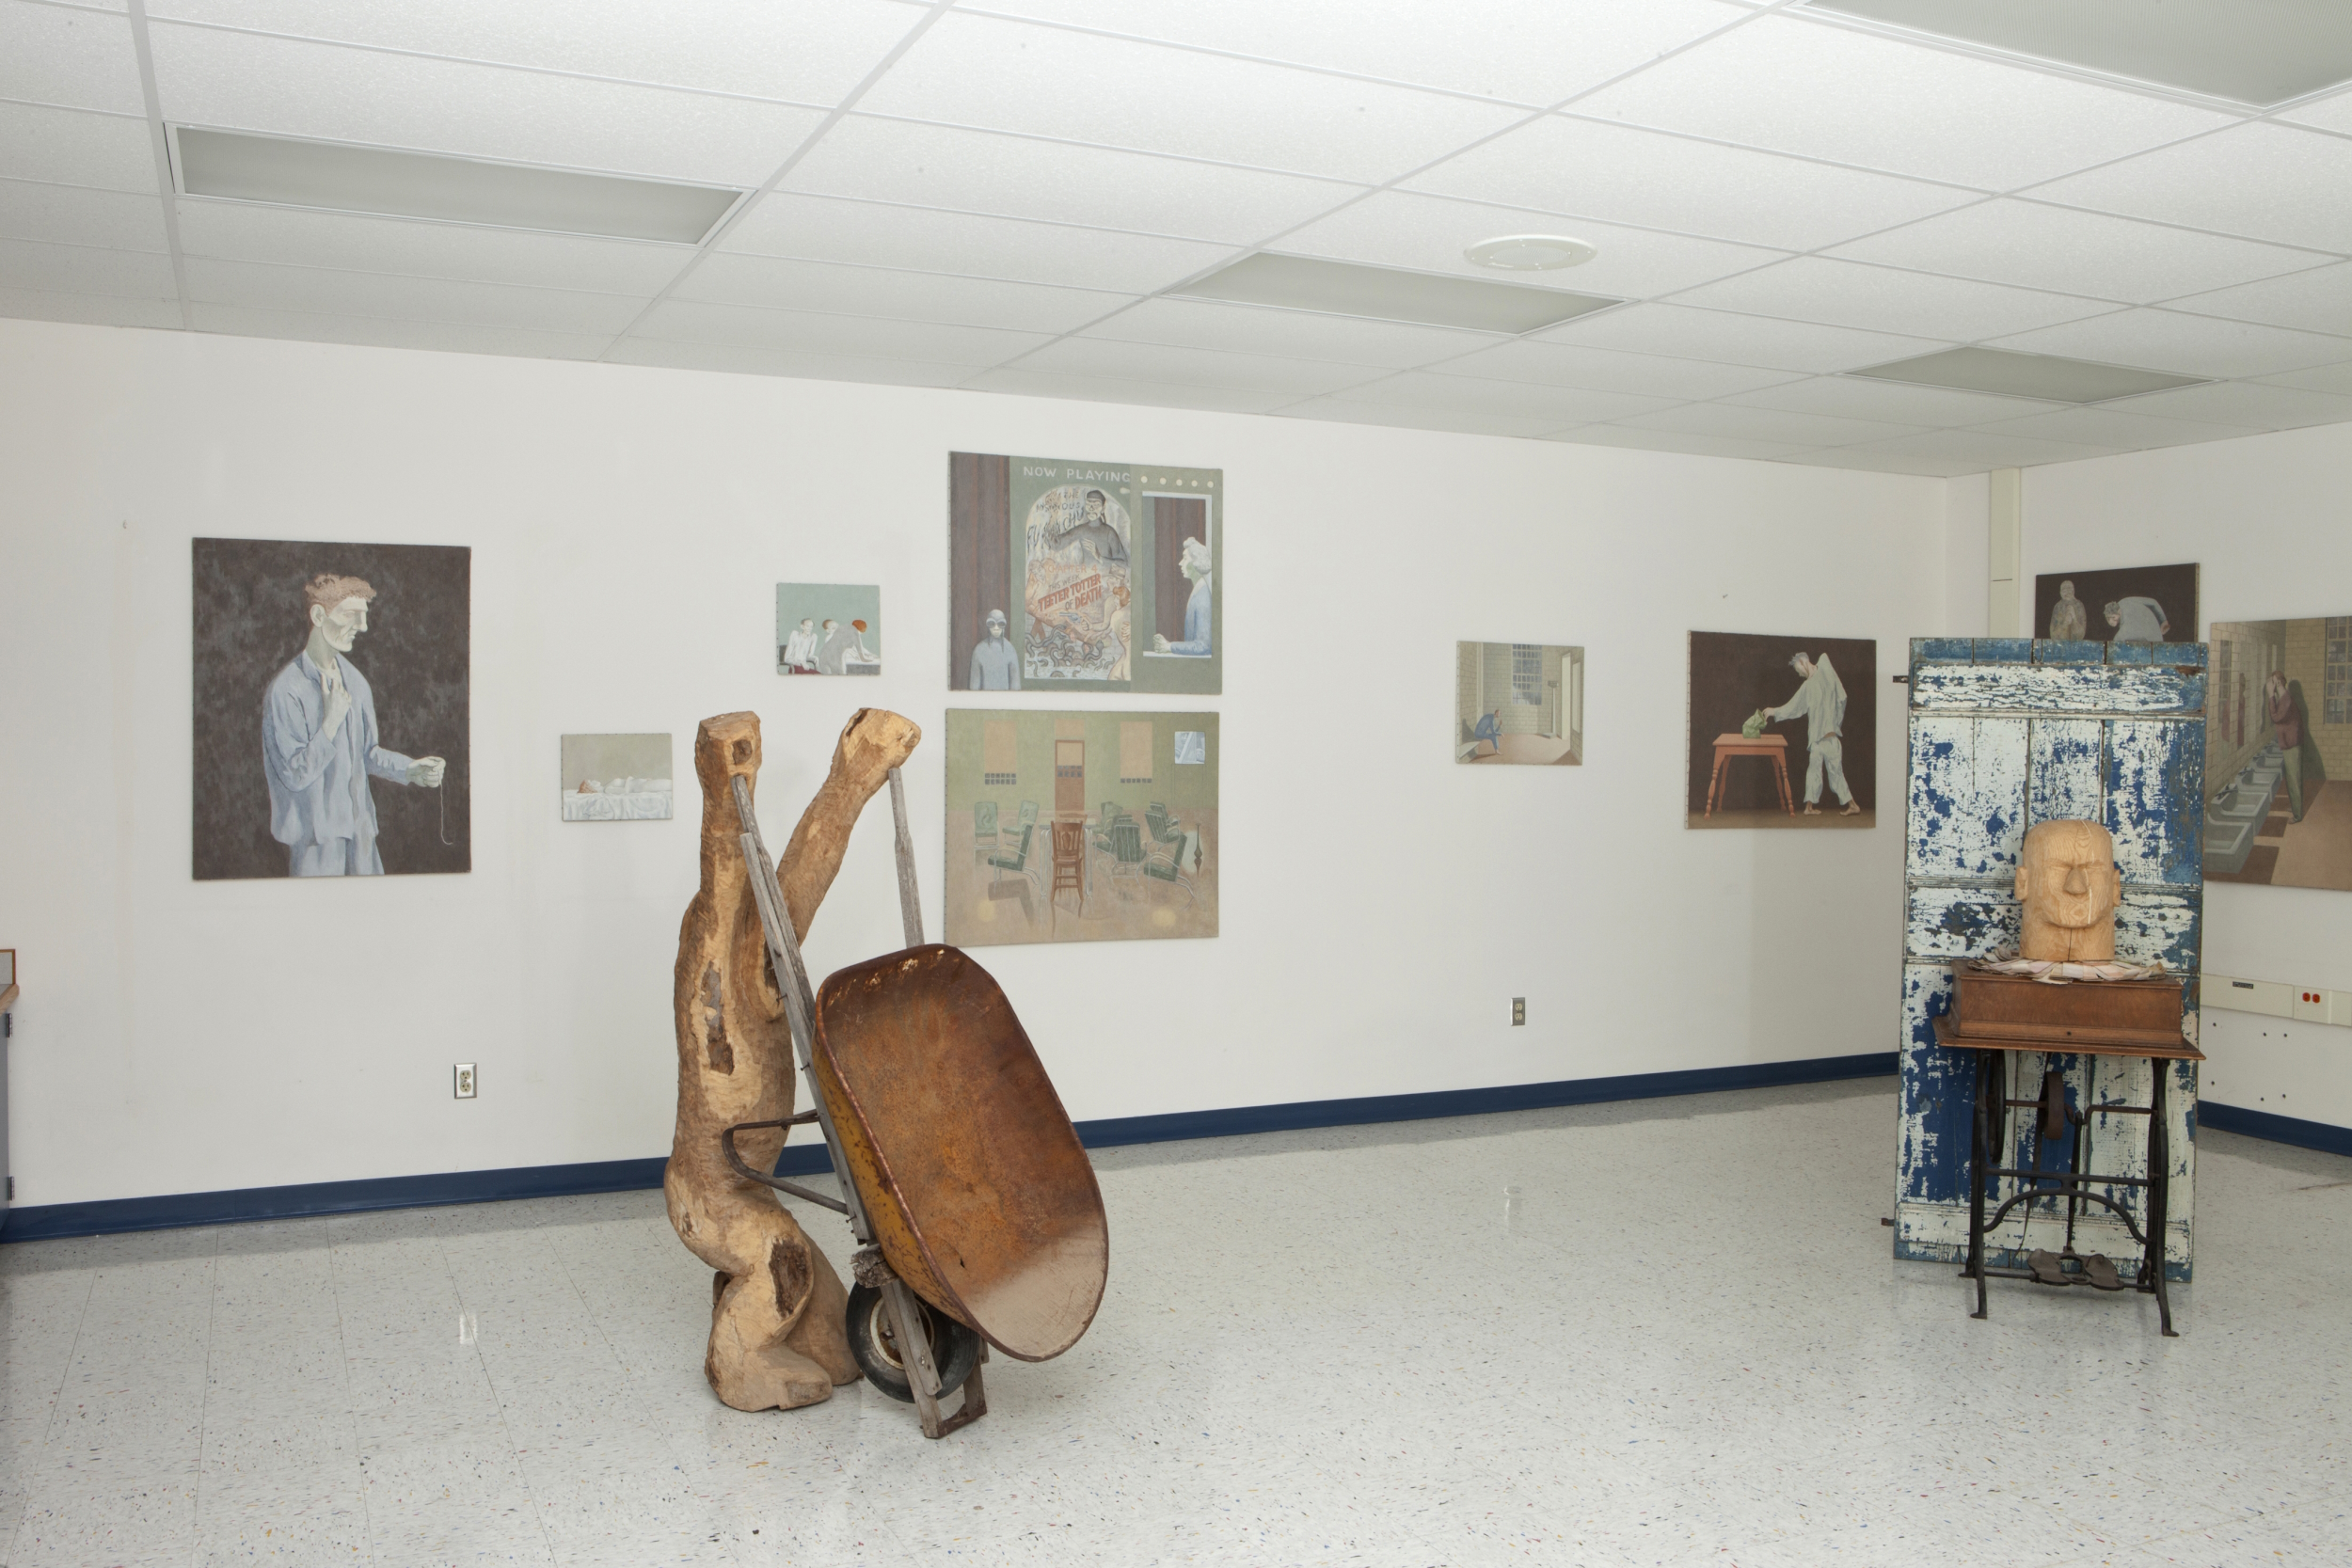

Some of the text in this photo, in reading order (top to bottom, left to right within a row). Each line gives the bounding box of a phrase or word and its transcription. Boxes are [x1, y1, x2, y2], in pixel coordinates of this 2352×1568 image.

[1023, 467, 1131, 483] NOW PLAYING
[1047, 563, 1098, 574] CHAPTER 4
[1049, 574, 1081, 592] THIS WEEK
[1038, 573, 1102, 612] TEETER TOTTER
[1065, 584, 1103, 610] OF DEATH
